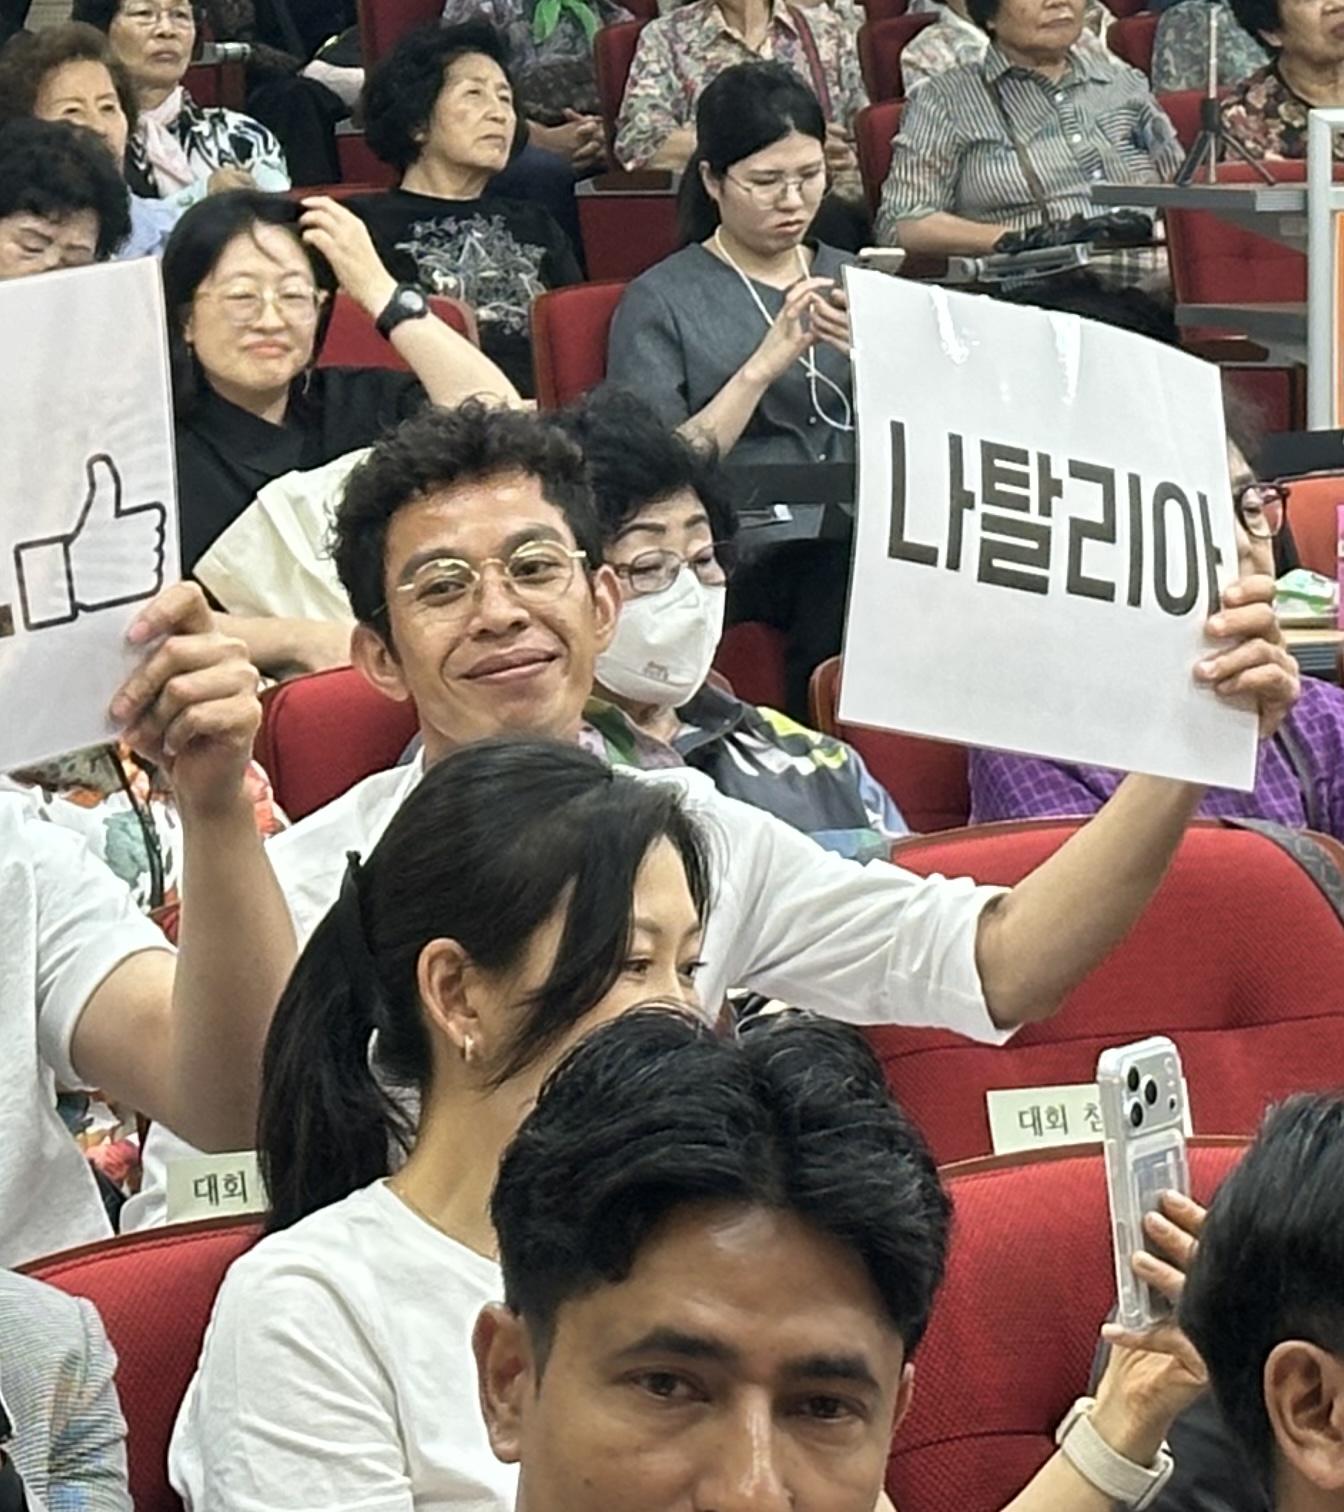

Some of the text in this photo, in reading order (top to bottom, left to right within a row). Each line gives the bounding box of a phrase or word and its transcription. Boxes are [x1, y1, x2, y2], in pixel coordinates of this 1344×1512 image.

[887, 419, 1223, 616] 나탈리아
[1018, 1104, 1069, 1137] 대회
[193, 1170, 248, 1206] 대회
